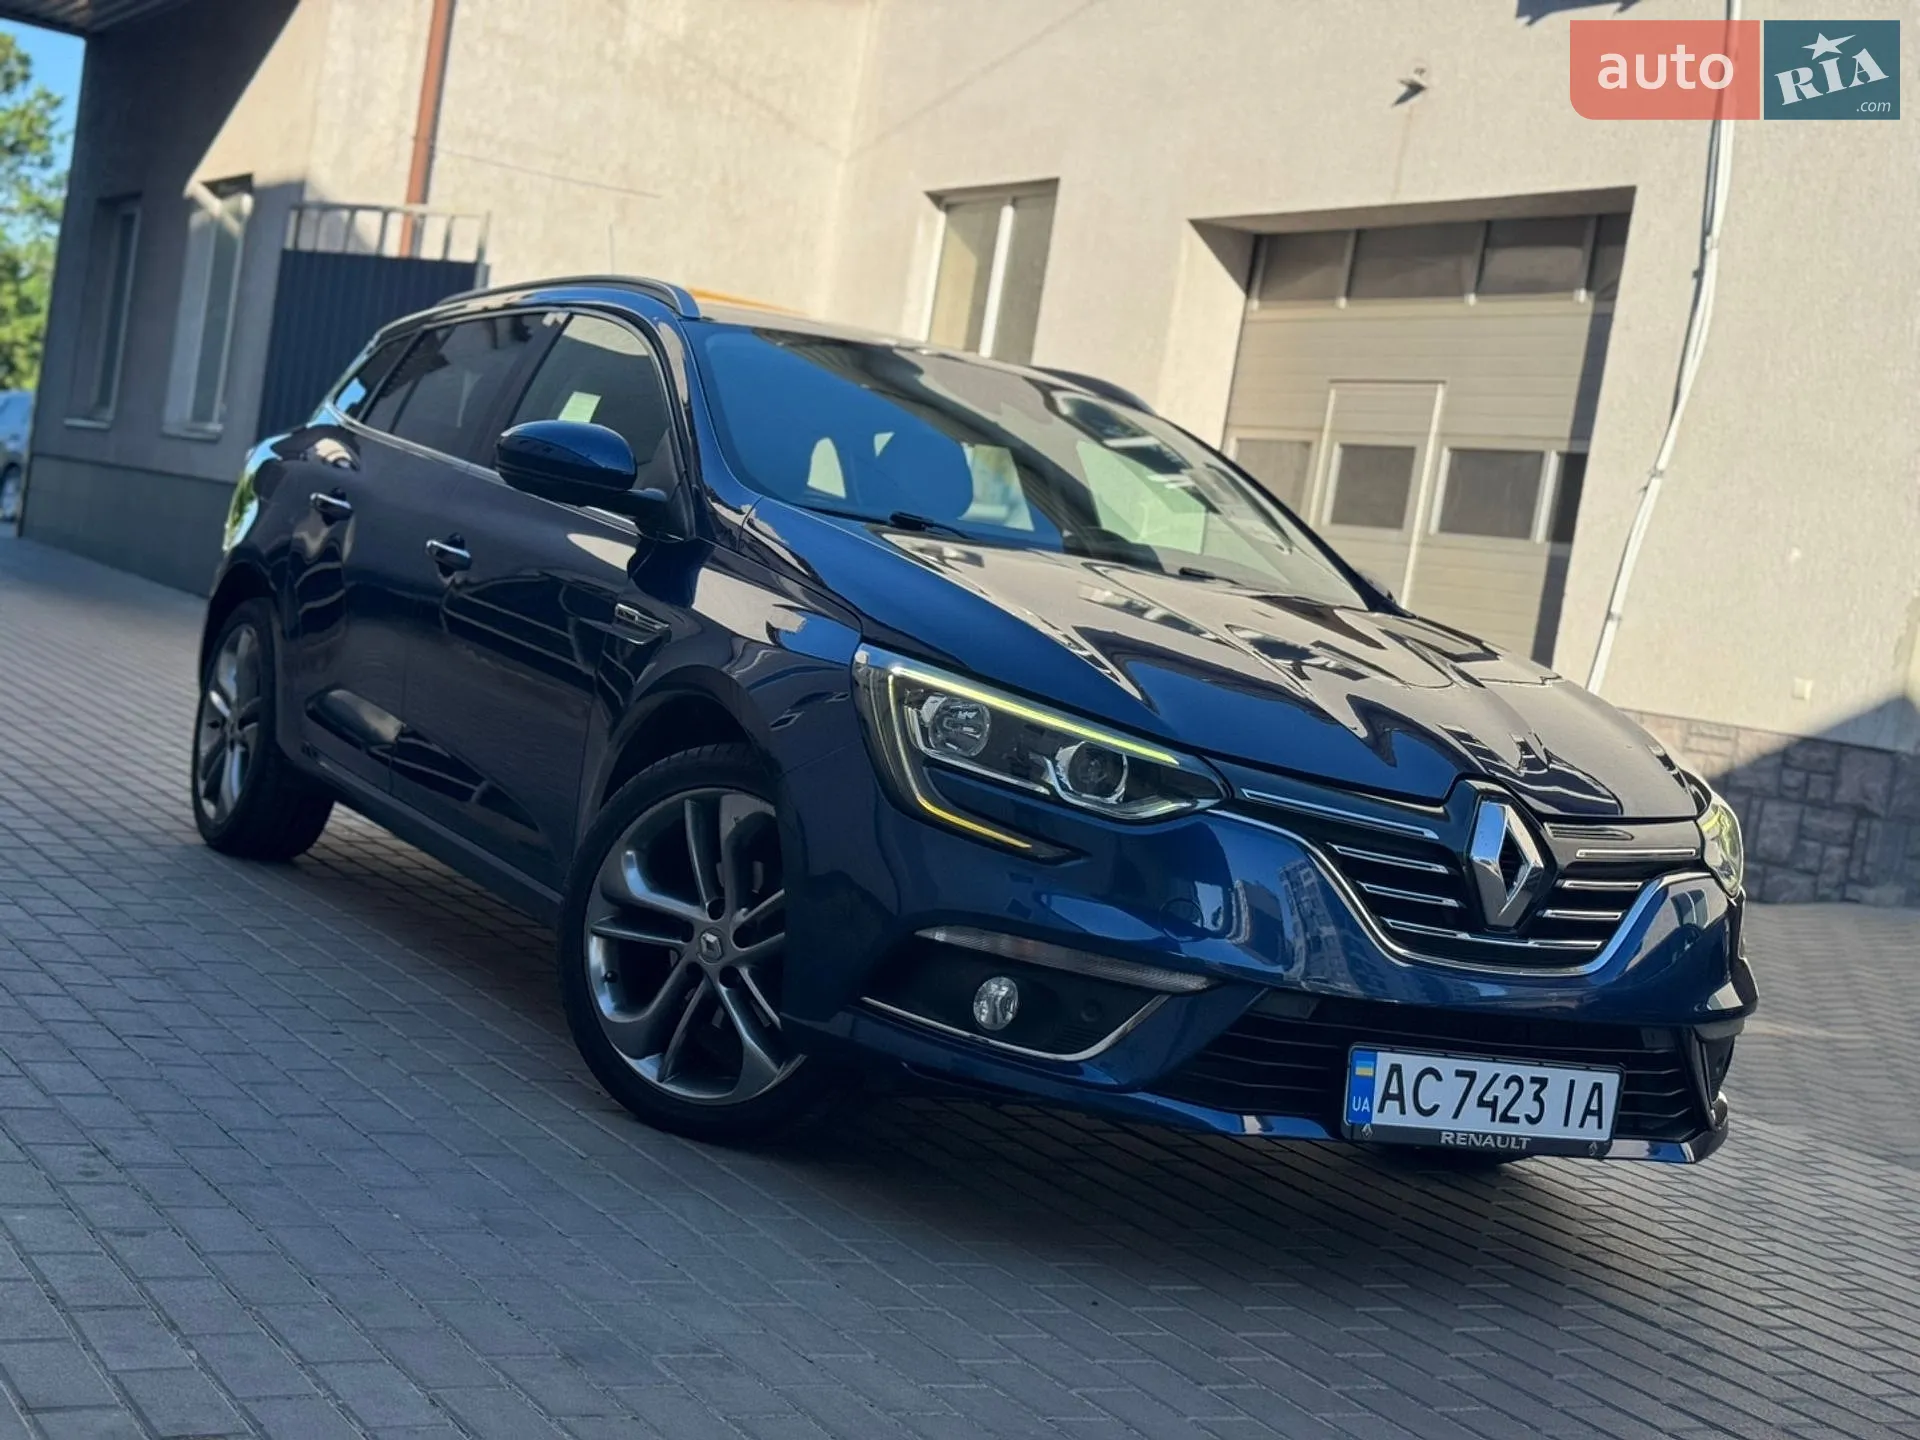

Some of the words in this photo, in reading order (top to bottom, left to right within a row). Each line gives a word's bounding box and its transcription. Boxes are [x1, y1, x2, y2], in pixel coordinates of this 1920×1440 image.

[1351, 1095, 1371, 1114] UA
[1377, 1063, 1443, 1117] AC
[1452, 1069, 1549, 1126] 7423
[1563, 1079, 1603, 1130] IA
[1440, 1131, 1532, 1151] RENAULT
